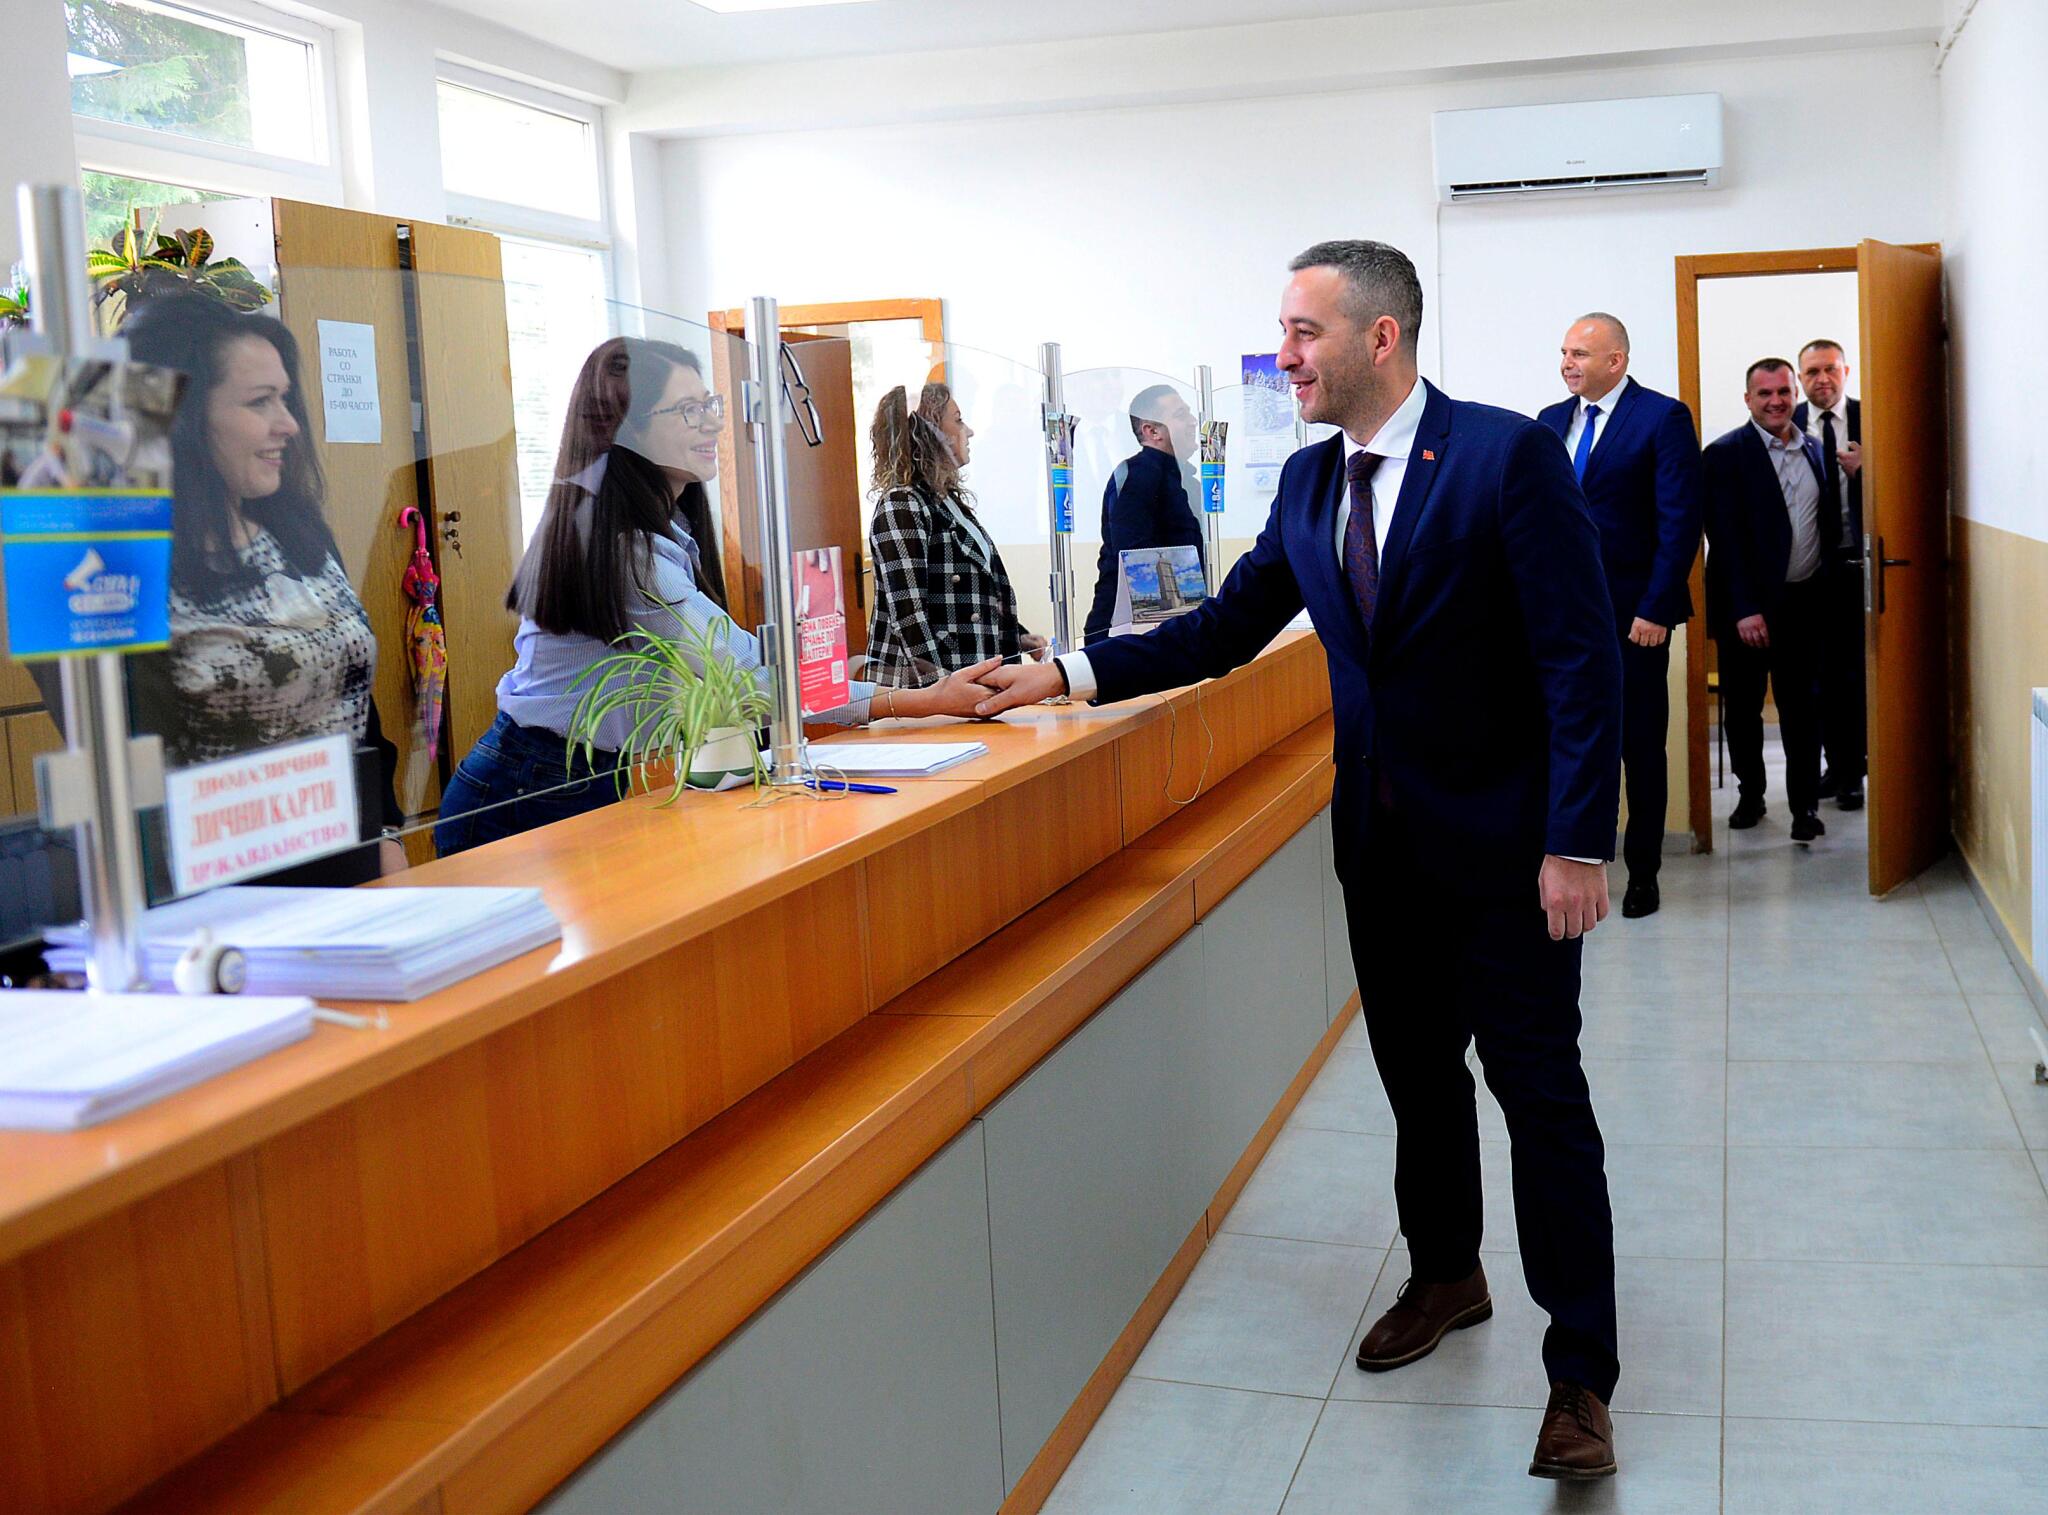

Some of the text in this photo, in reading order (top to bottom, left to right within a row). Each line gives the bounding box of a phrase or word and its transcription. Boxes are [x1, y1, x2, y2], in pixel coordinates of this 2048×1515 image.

[328, 347, 358, 359] РАБОТА
[339, 361, 351, 371] СО
[327, 373, 362, 385] СТРАНКИ
[341, 387, 353, 397] ДО
[349, 401, 374, 411] ЧАСОТ
[191, 780, 337, 847] ЛИЧНИ КАРТИ
